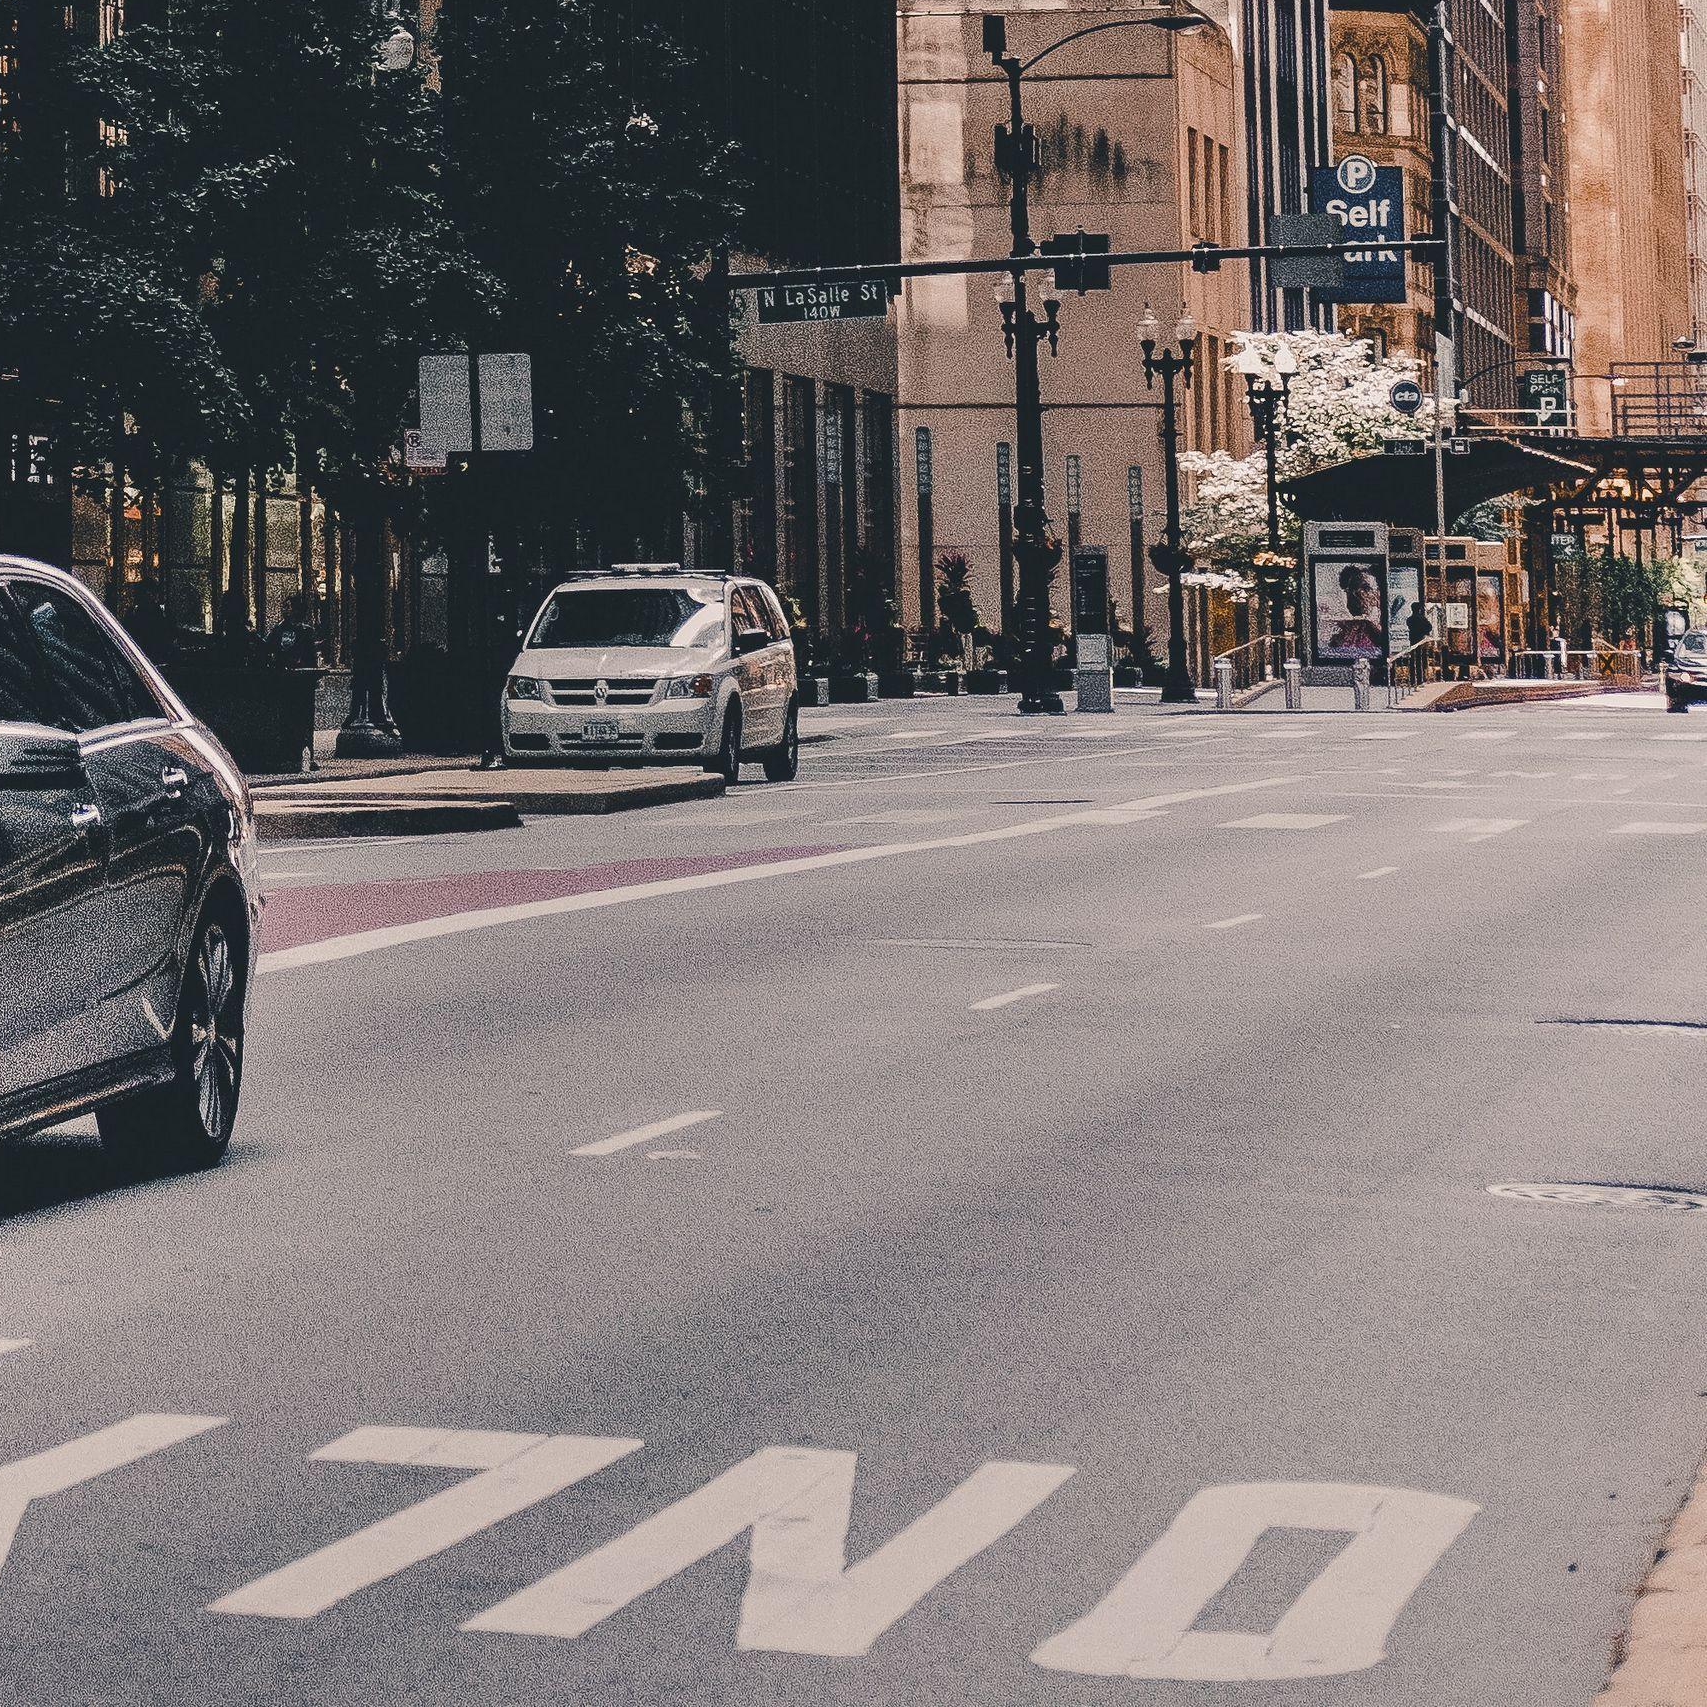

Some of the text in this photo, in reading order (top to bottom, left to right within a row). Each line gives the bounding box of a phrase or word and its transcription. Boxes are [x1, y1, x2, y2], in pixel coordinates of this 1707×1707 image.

[1326, 199, 1390, 228] Self
[1343, 233, 1398, 262] ark
[764, 284, 878, 307] N LaSalle St
[803, 305, 841, 320] 140W
[1529, 374, 1559, 384] SELF
[1395, 391, 1418, 402] cta
